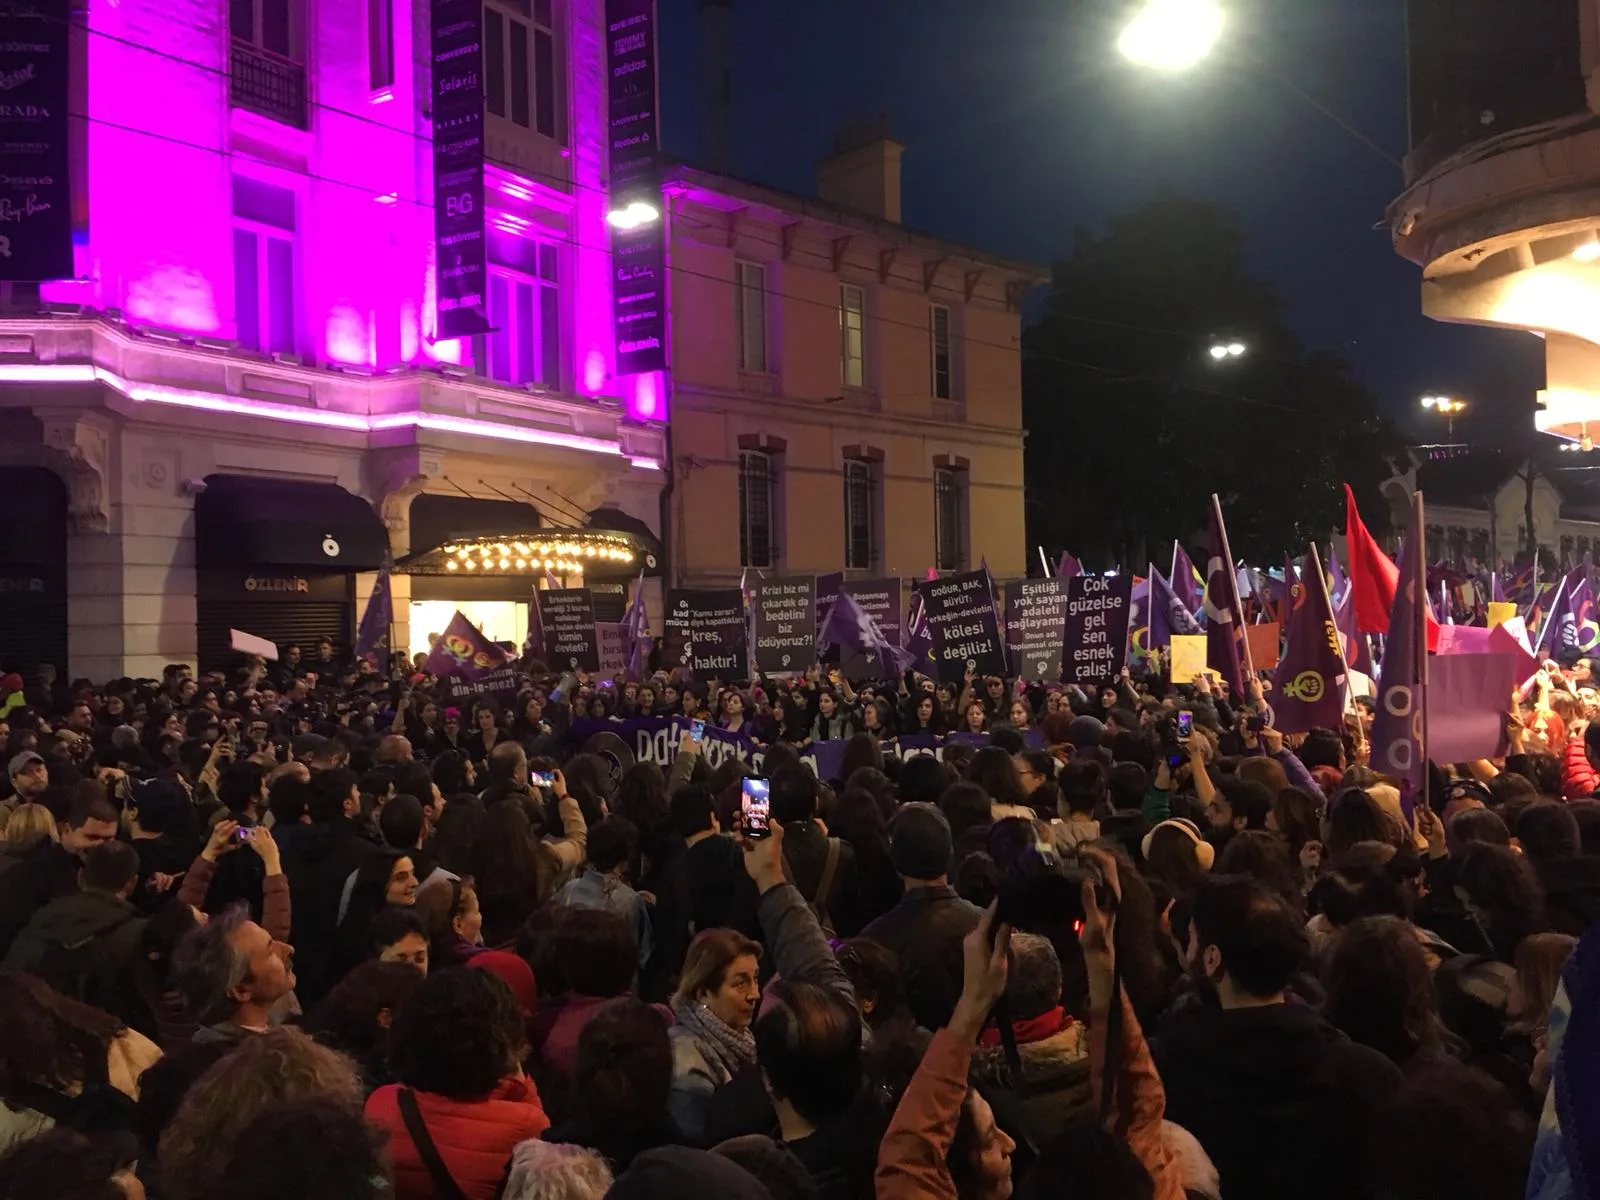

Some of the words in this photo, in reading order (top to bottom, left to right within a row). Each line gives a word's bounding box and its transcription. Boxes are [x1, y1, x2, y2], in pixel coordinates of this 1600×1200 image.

[0, 105, 49, 117] RADA
[762, 586, 782, 596] Krizi
[784, 585, 797, 594] biz
[798, 584, 809, 593] mi
[931, 583, 962, 598] DOĞUR,
[962, 578, 983, 592] BAK,
[1022, 584, 1060, 596] Eşitliği
[1083, 578, 1110, 595] Çok
[762, 598, 796, 610] çıkardık
[798, 597, 809, 606] da
[943, 595, 973, 608] BÜYÜT:
[1014, 597, 1035, 609] yok
[1036, 594, 1068, 607] sayan
[1069, 596, 1123, 615] güzelse
[766, 609, 806, 622] bedelini
[1022, 606, 1060, 616] adaleti
[1007, 617, 1066, 631] sağlayama
[1084, 613, 1106, 628] gel
[778, 623, 793, 633] biz
[943, 621, 984, 640] kölesi
[1024, 631, 1044, 639] Onun
[1046, 630, 1058, 639] adı
[558, 632, 583, 641] kimin
[692, 630, 722, 645] kreş,
[758, 635, 814, 649] ödüyoruz?!
[1082, 631, 1107, 644] sen
[554, 642, 588, 652] devleti?
[943, 639, 993, 660] değiliz!
[1047, 640, 1064, 648] cins
[1074, 646, 1115, 662] esnek
[695, 654, 737, 670] haktır!
[1075, 662, 1112, 680] çalış!
